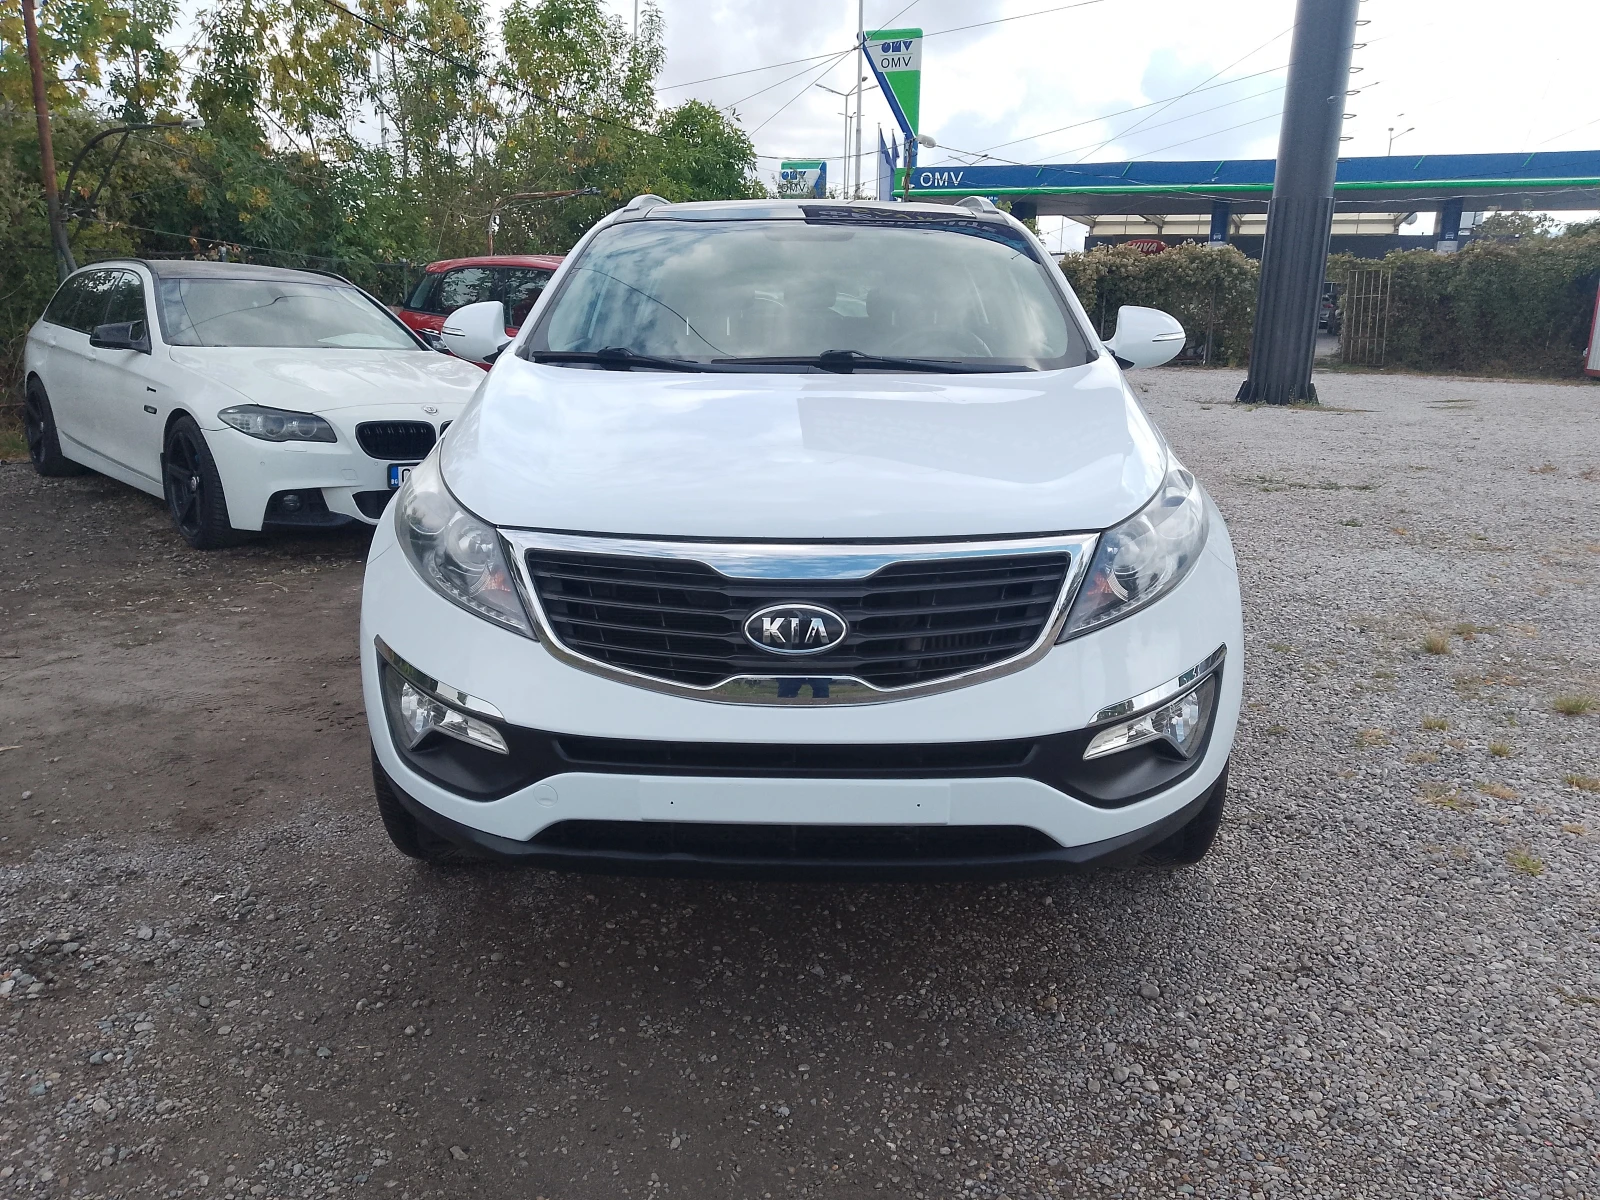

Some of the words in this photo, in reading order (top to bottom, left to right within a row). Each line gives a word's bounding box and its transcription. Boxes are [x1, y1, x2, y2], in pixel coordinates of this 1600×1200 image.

[881, 56, 912, 68] OMV
[920, 171, 964, 187] OMV
[761, 617, 830, 643] KIA
